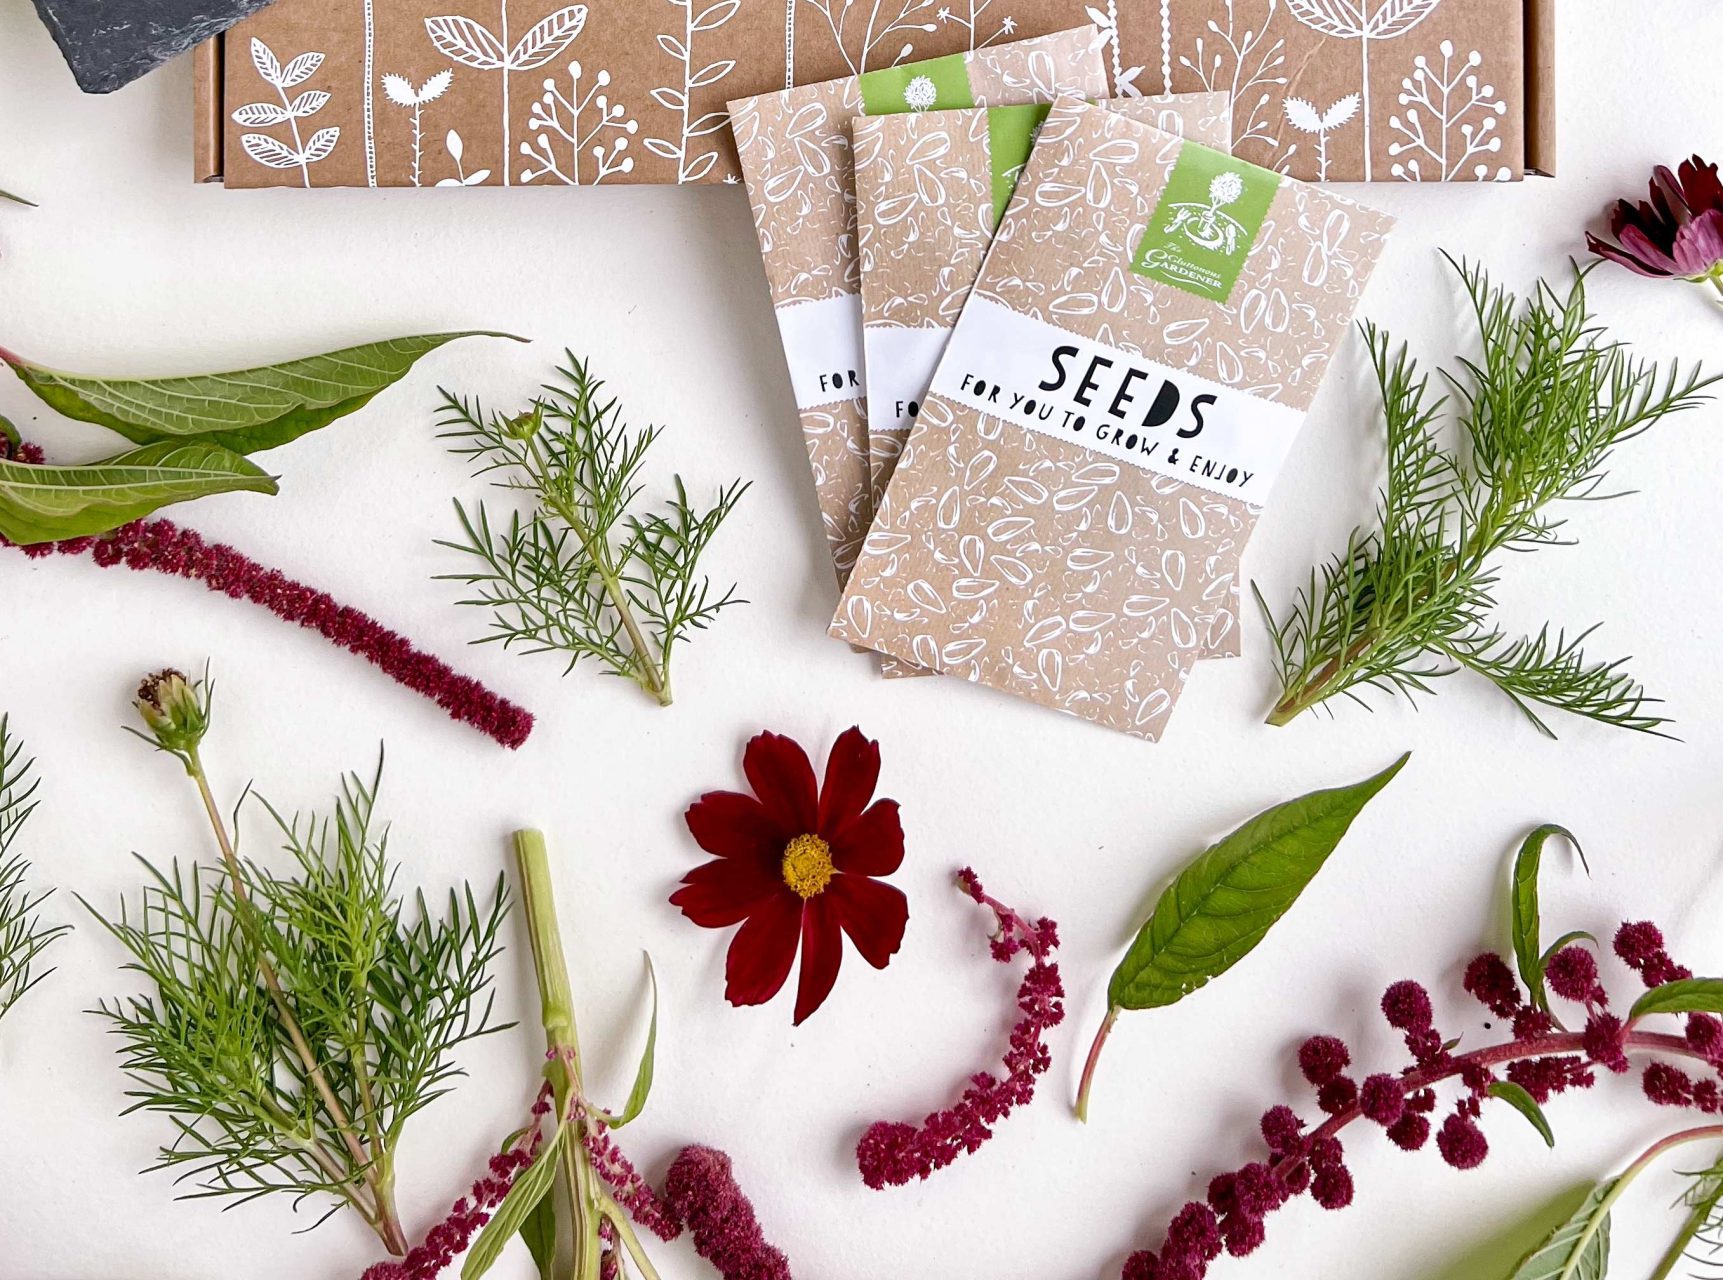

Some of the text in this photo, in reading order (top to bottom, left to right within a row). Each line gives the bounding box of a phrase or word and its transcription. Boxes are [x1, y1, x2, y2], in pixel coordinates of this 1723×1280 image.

[1141, 248, 1222, 288] GARDENER
[1168, 254, 1222, 279] Gluttonous
[819, 370, 860, 392] FOR
[1038, 345, 1218, 439] SEEDS
[960, 373, 1255, 488] FOR YOU TO GROW & ENJOY
